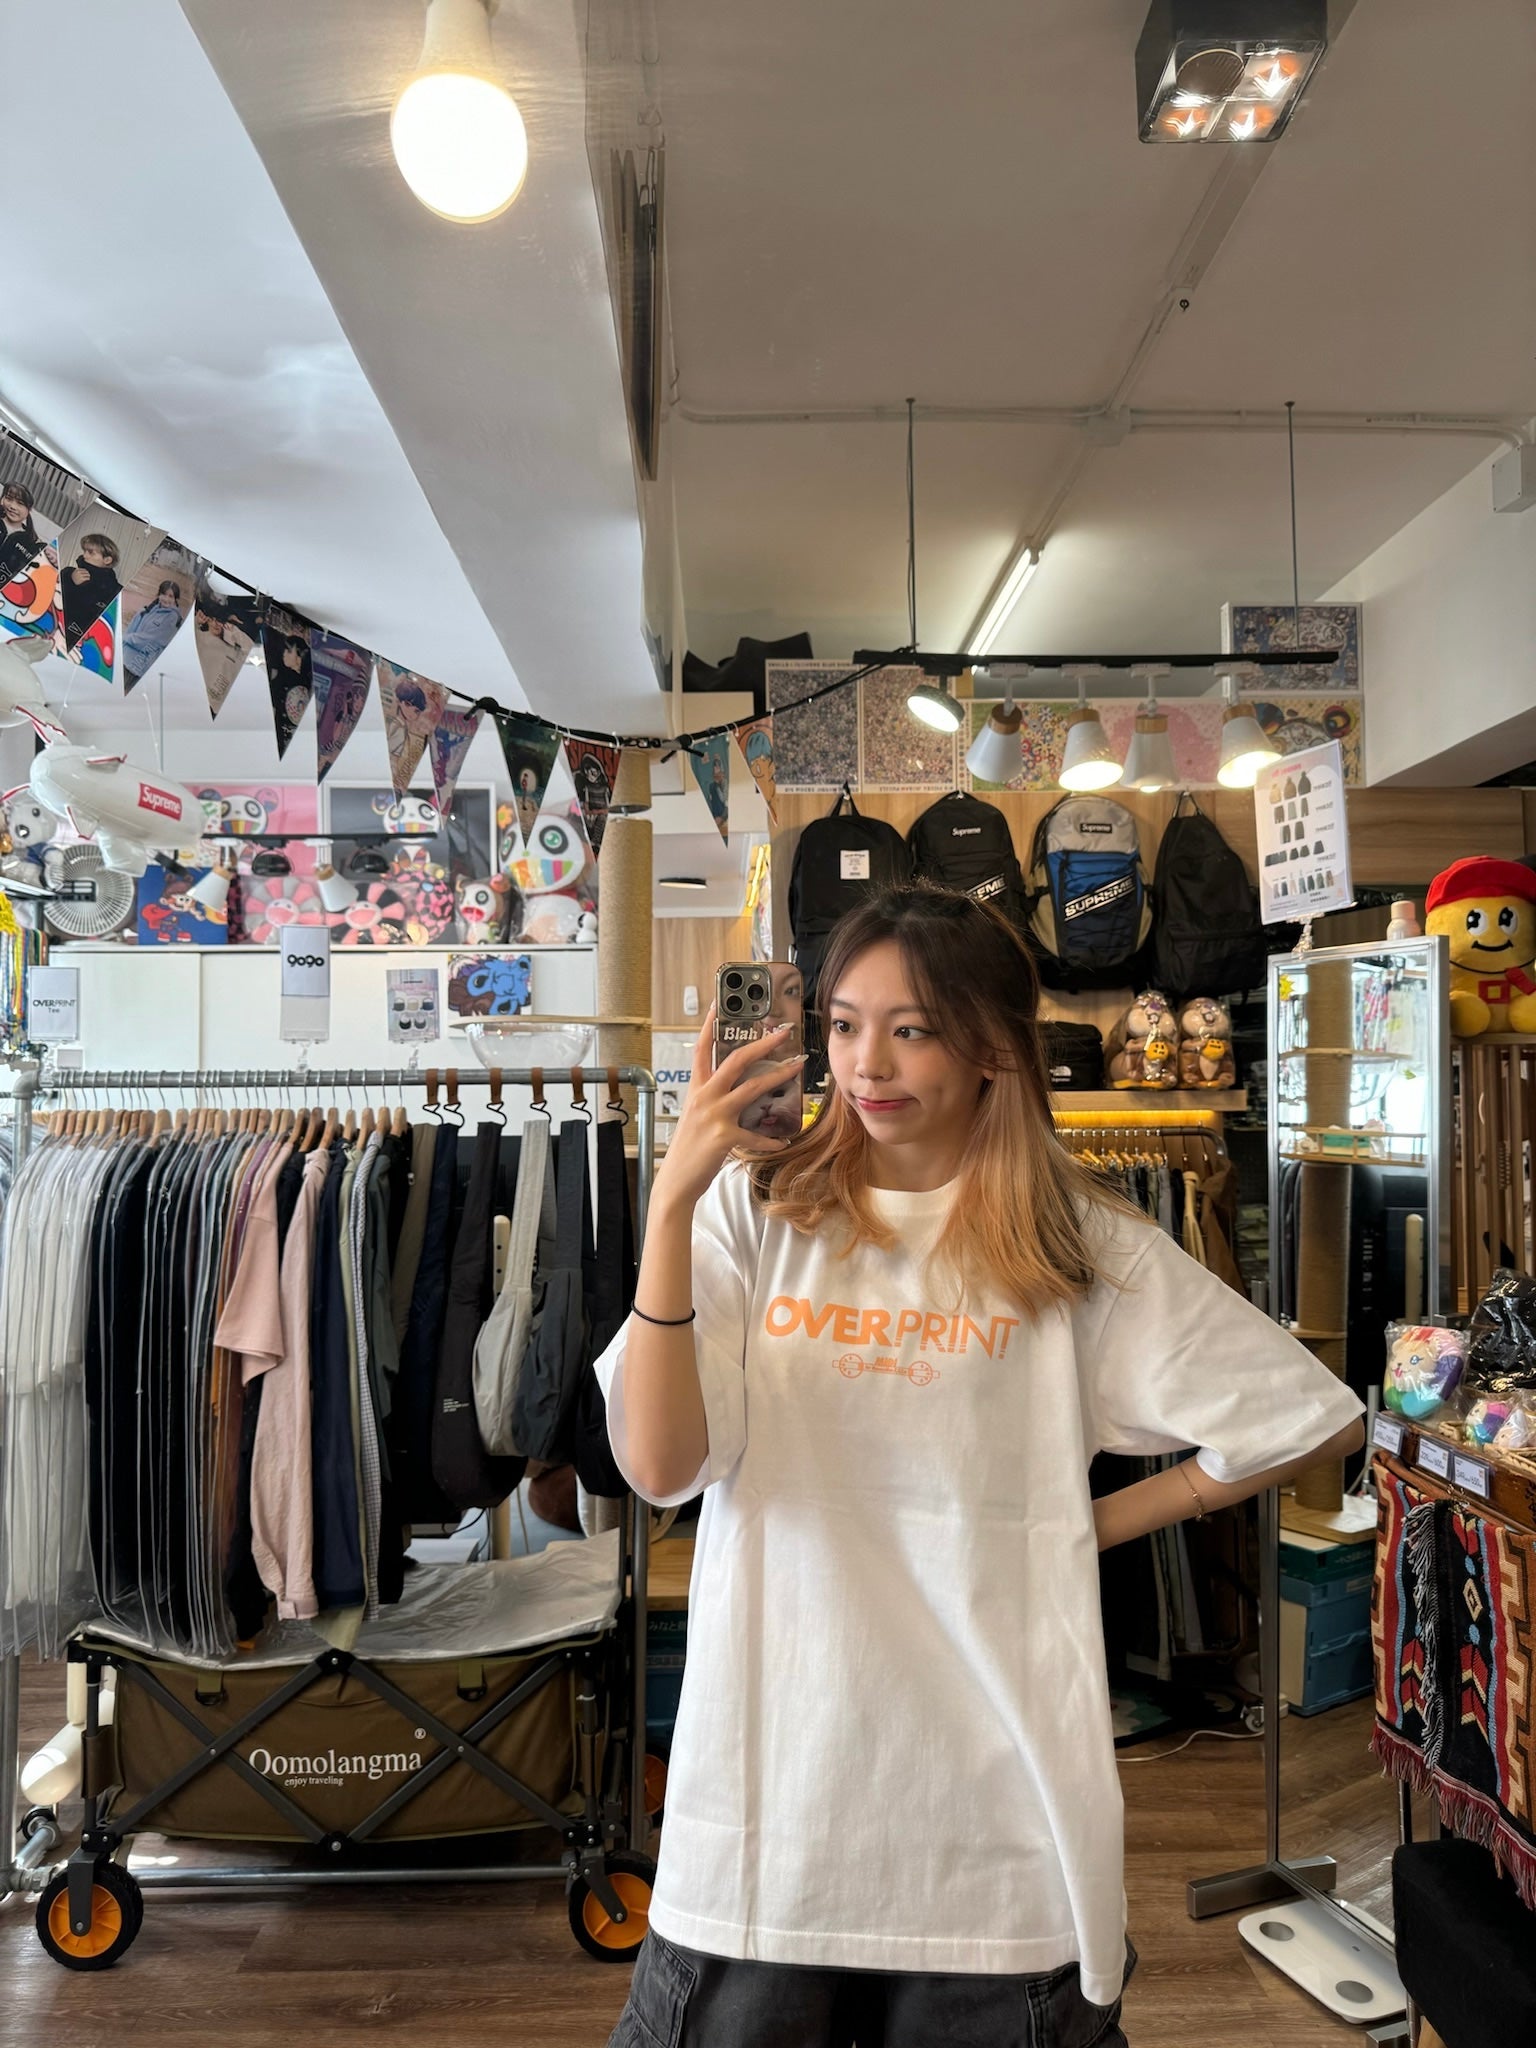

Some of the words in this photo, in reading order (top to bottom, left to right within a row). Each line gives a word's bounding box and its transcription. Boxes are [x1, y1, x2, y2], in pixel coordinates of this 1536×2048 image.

[142, 786, 181, 814] Supreme
[952, 827, 981, 837] Supreme
[1081, 823, 1111, 833] Supreme
[1064, 876, 1136, 917] SUPREME
[724, 1026, 758, 1041] Blah
[765, 1295, 1020, 1360] OVERPRINT
[284, 1776, 308, 1789] enjoy
[308, 1775, 344, 1786] traveling
